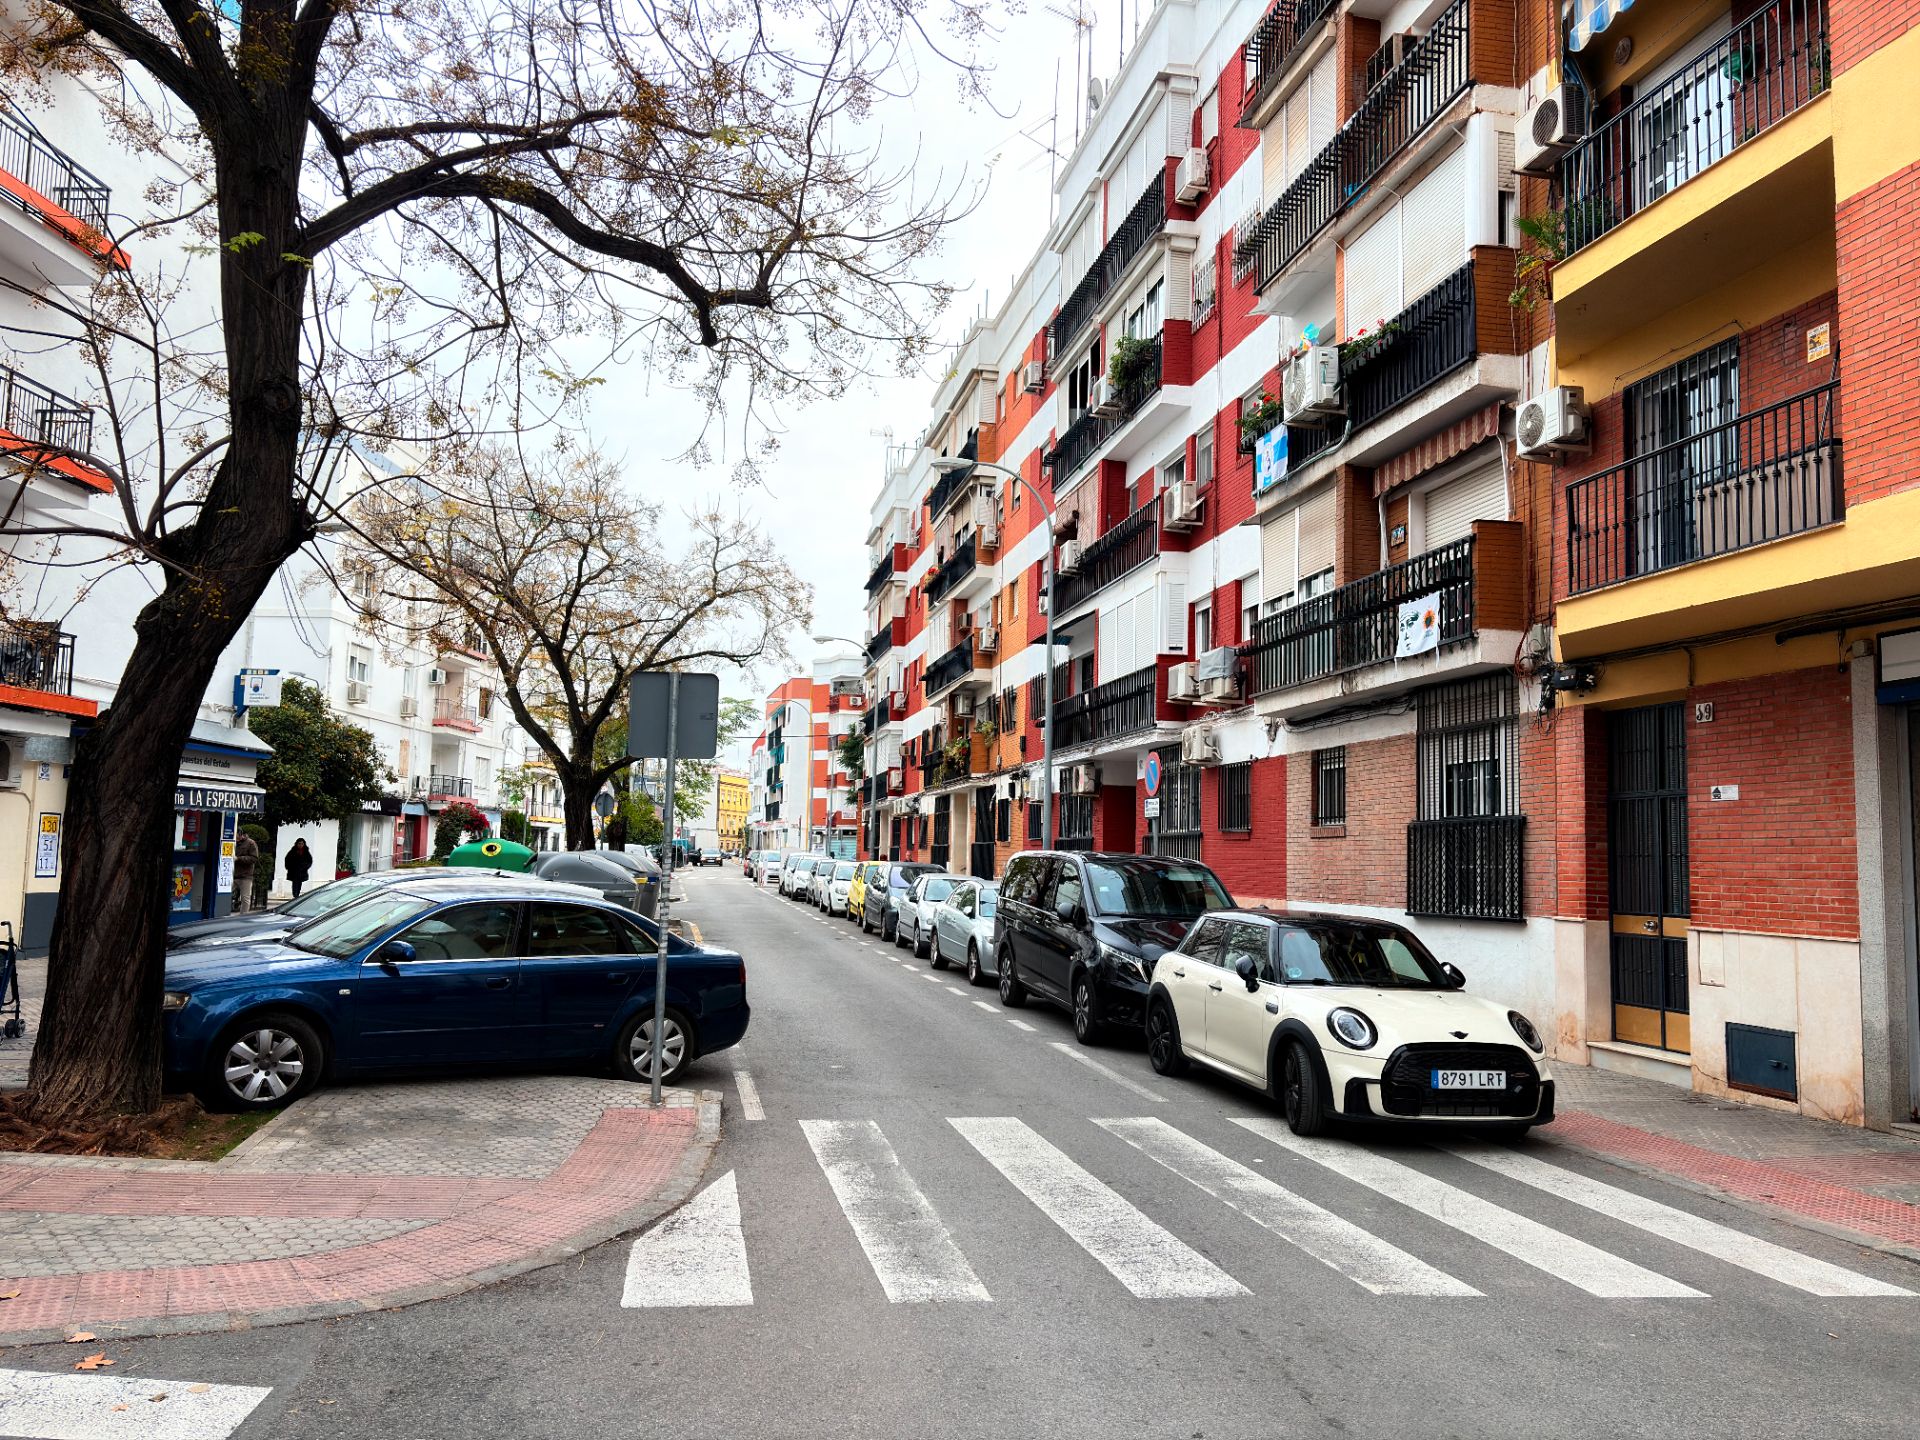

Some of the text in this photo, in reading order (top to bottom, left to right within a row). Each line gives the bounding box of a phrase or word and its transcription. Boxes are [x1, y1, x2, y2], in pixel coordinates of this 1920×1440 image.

[203, 757, 213, 767] del
[212, 759, 231, 769] Estado
[189, 789, 203, 807] LA
[206, 790, 258, 810] ESPERANZA
[42, 821, 57, 833] 130
[44, 839, 53, 852] 51
[1441, 1072, 1473, 1087] 8791
